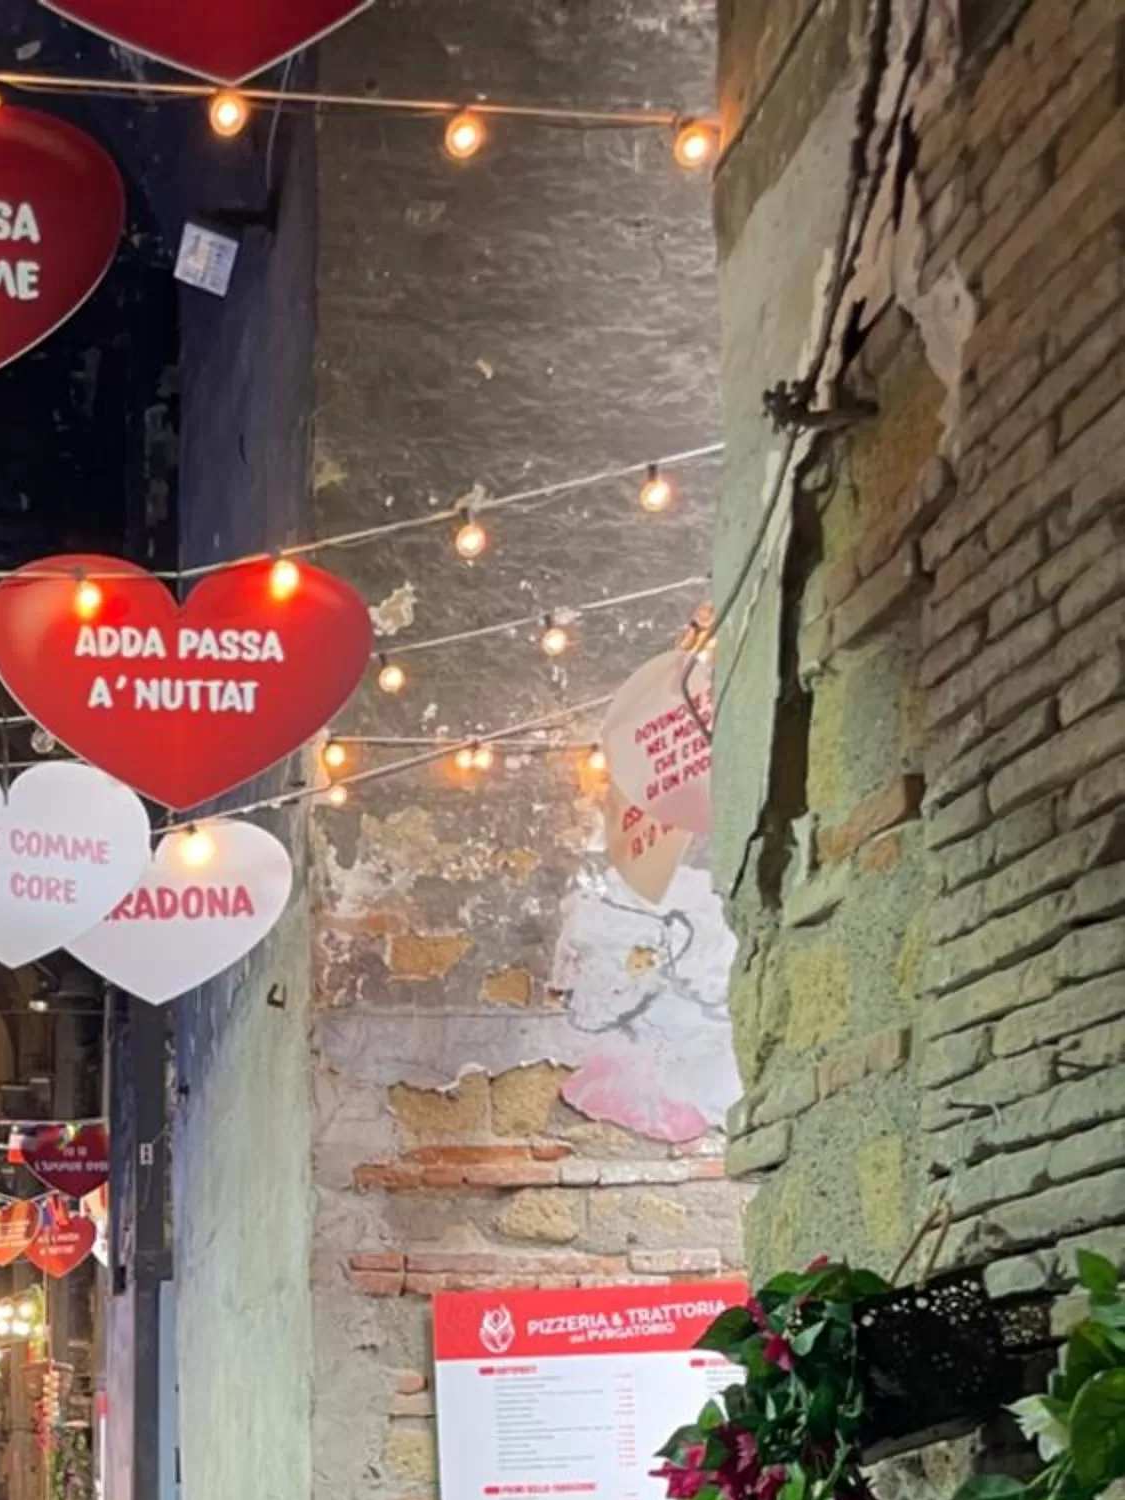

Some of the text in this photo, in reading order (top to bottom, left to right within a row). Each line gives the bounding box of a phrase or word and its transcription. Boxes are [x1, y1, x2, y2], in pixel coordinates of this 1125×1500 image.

[75, 625, 285, 663] ADDA PASSA
[9, 828, 111, 866] COMME
[9, 872, 77, 905] CORE
[103, 885, 255, 922] RADONA
[527, 1313, 608, 1338] PIZZERIA
[626, 1300, 726, 1325] TRATTORIA
